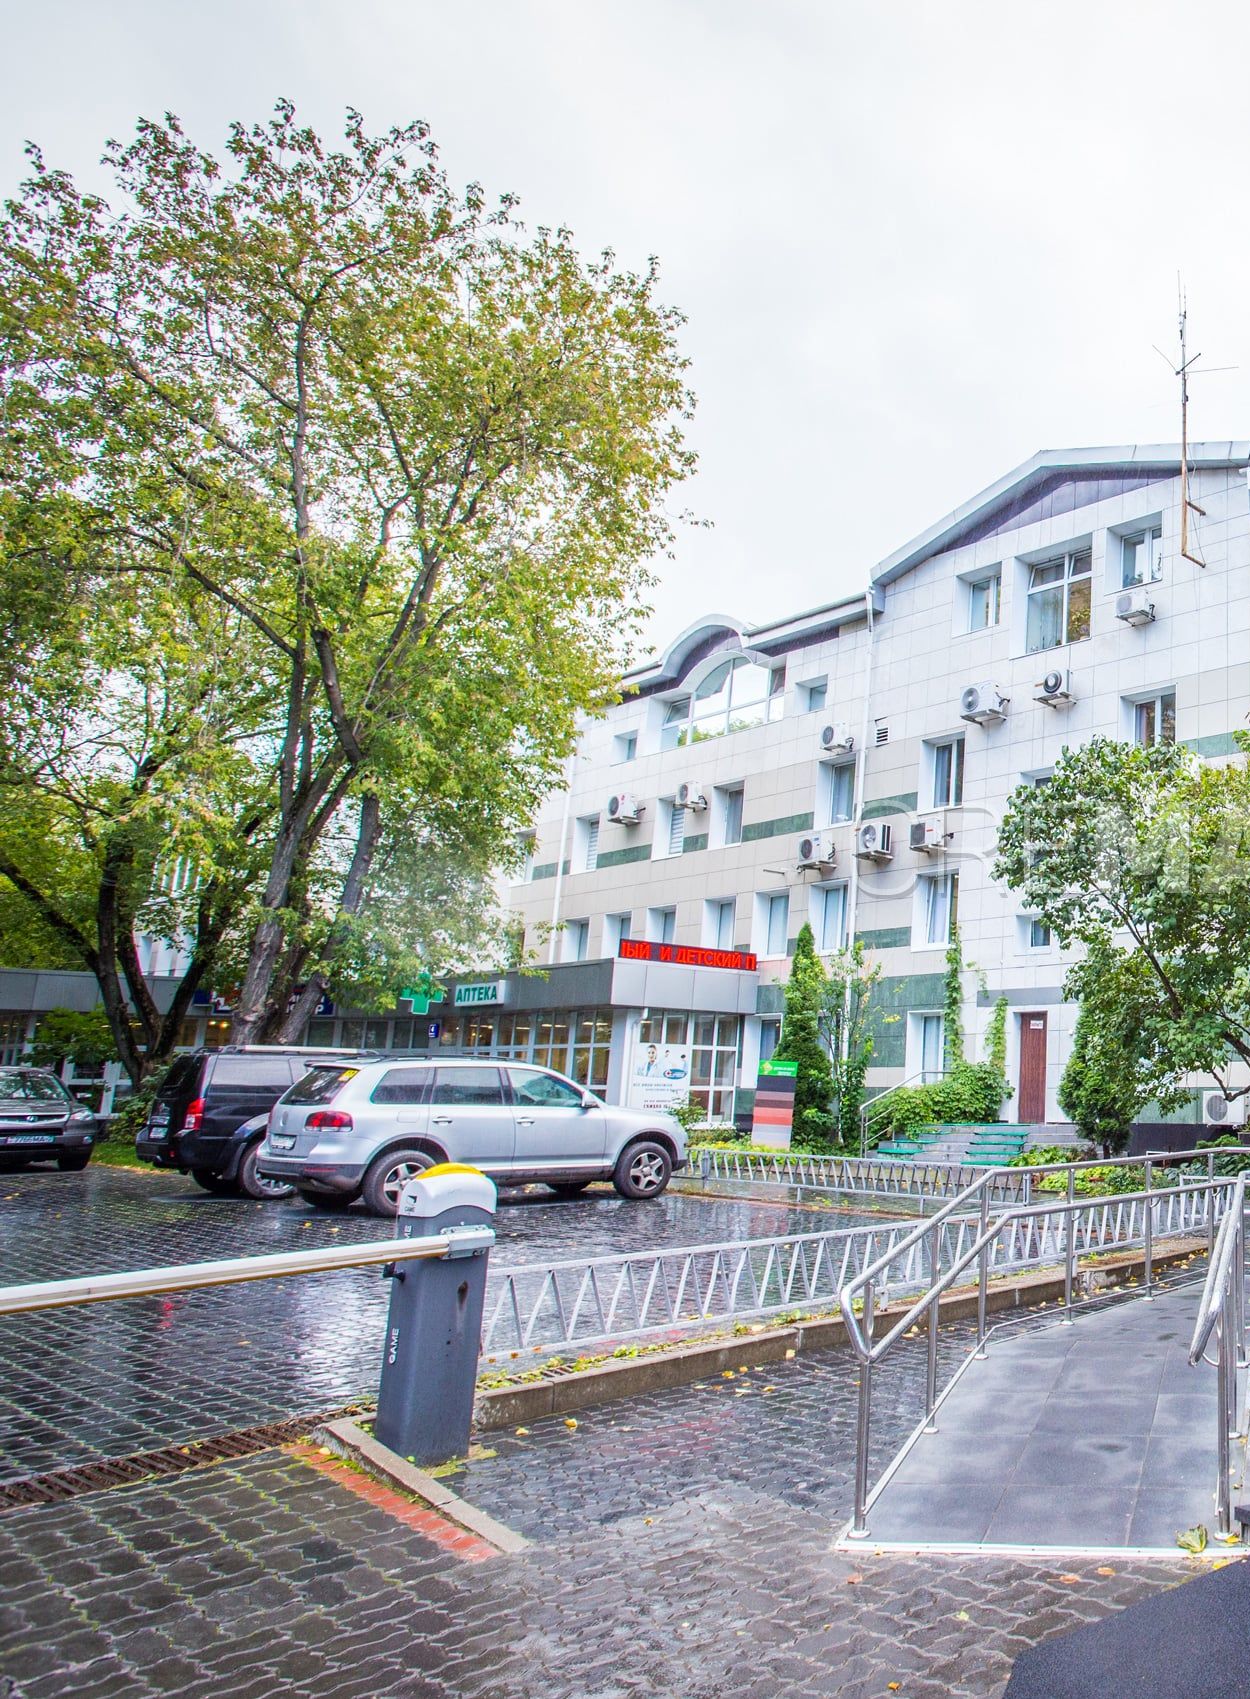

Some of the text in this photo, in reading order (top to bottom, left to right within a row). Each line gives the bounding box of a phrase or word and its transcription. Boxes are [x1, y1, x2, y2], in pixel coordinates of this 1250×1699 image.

[660, 946, 673, 960] И
[676, 948, 741, 968] ДЕТСКИЙ
[456, 986, 497, 1003] АПТЕКА
[388, 1327, 400, 1364] CAME
